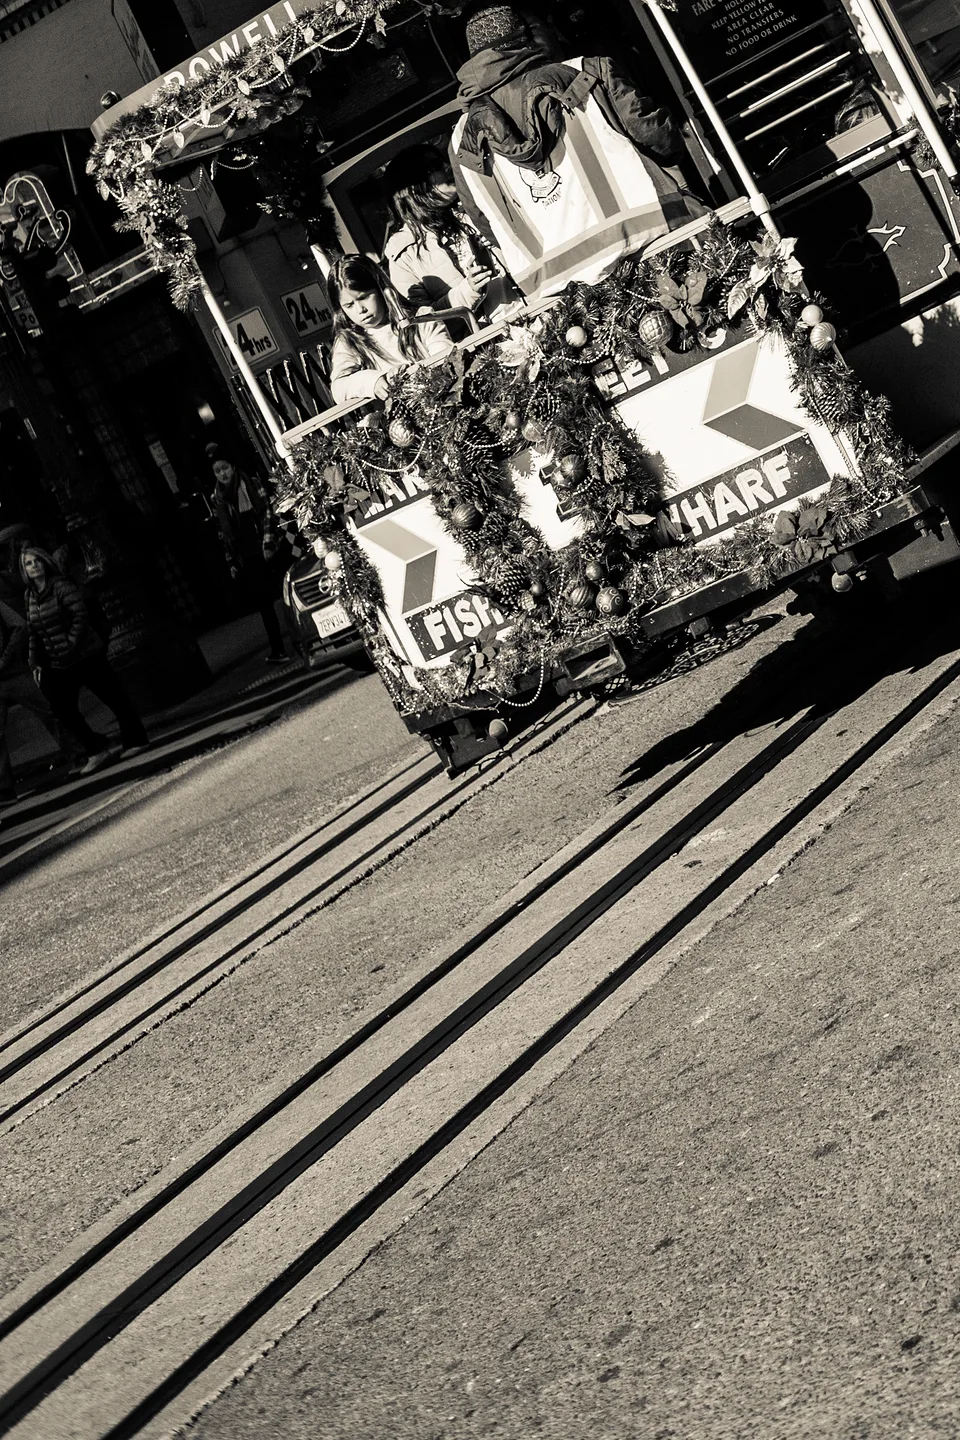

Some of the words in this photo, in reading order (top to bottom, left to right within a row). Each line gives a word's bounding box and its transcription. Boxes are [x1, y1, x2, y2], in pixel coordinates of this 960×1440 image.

[711, 16, 728, 30] KEEP
[728, 0, 757, 20] YELLOW
[727, 17, 748, 32] AREA
[749, 2, 775, 20] CLEAR
[727, 33, 740, 44] NO
[741, 9, 785, 37] TRANSFERS
[725, 47, 738, 57] NO
[738, 34, 760, 50] FOOD
[760, 28, 773, 38] OR
[772, 14, 798, 32] DRINK
[655, 451, 791, 547] WHARF
[423, 595, 504, 651] FISH
